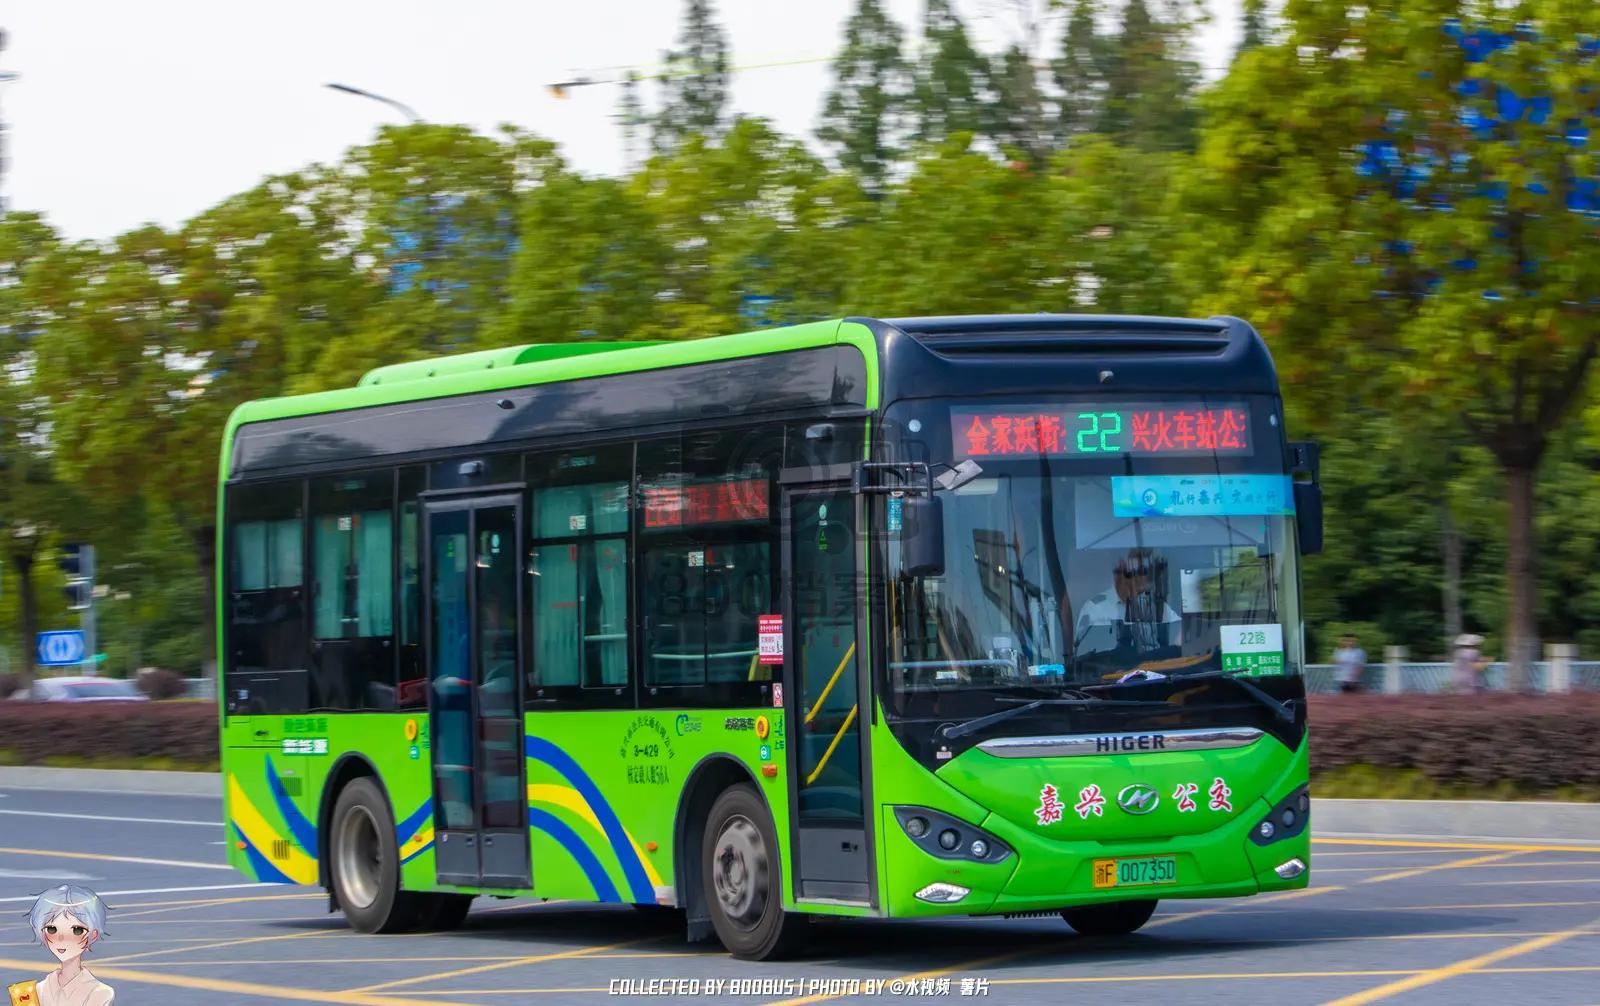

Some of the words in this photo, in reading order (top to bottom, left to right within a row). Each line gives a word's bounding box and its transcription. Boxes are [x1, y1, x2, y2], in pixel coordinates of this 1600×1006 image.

[1076, 412, 1122, 452] 22
[1239, 630, 1266, 645] 22路
[633, 744, 659, 757] 3-429
[1096, 734, 1165, 752] HIGER
[1035, 783, 1106, 825] 嘉兴
[1172, 777, 1233, 813] 公交
